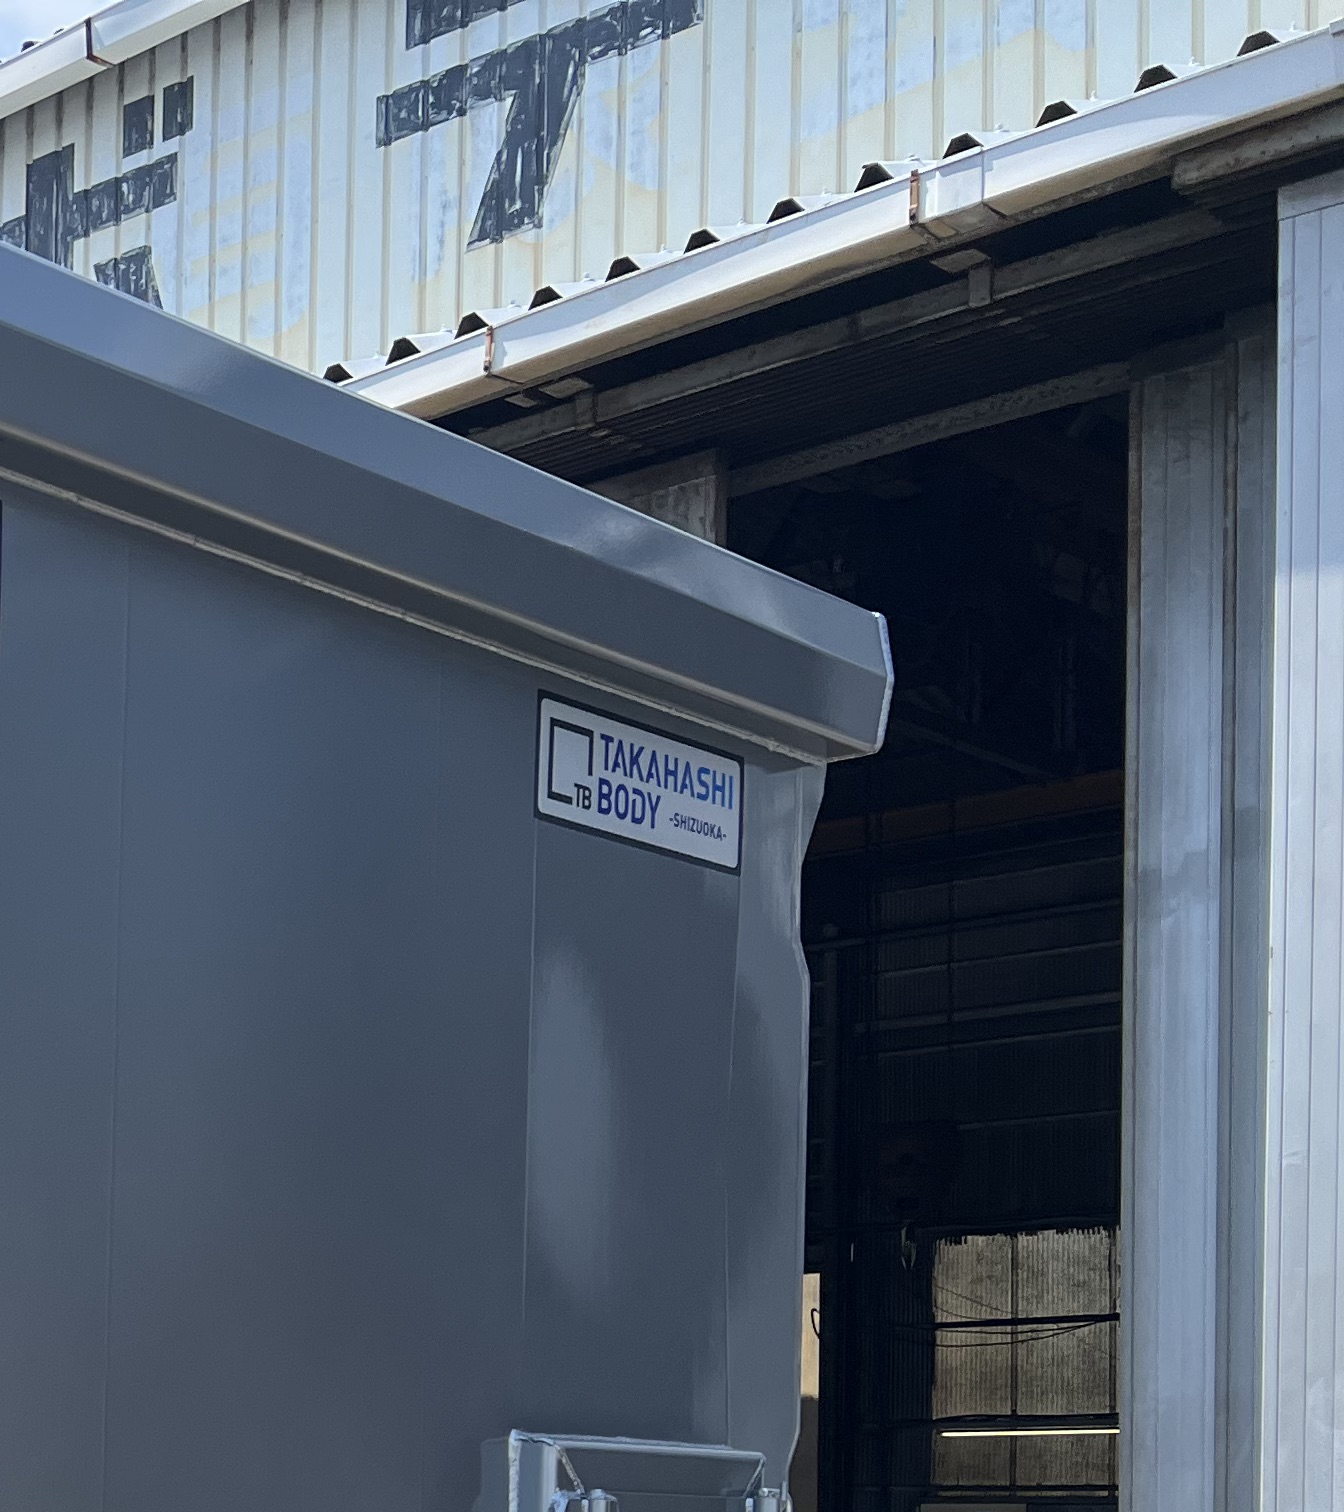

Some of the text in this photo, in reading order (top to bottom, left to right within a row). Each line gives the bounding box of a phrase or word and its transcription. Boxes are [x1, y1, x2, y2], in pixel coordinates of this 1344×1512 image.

[574, 782, 592, 810] TB
[600, 733, 734, 810] TAKAHASHI
[597, 777, 661, 829] BODY
